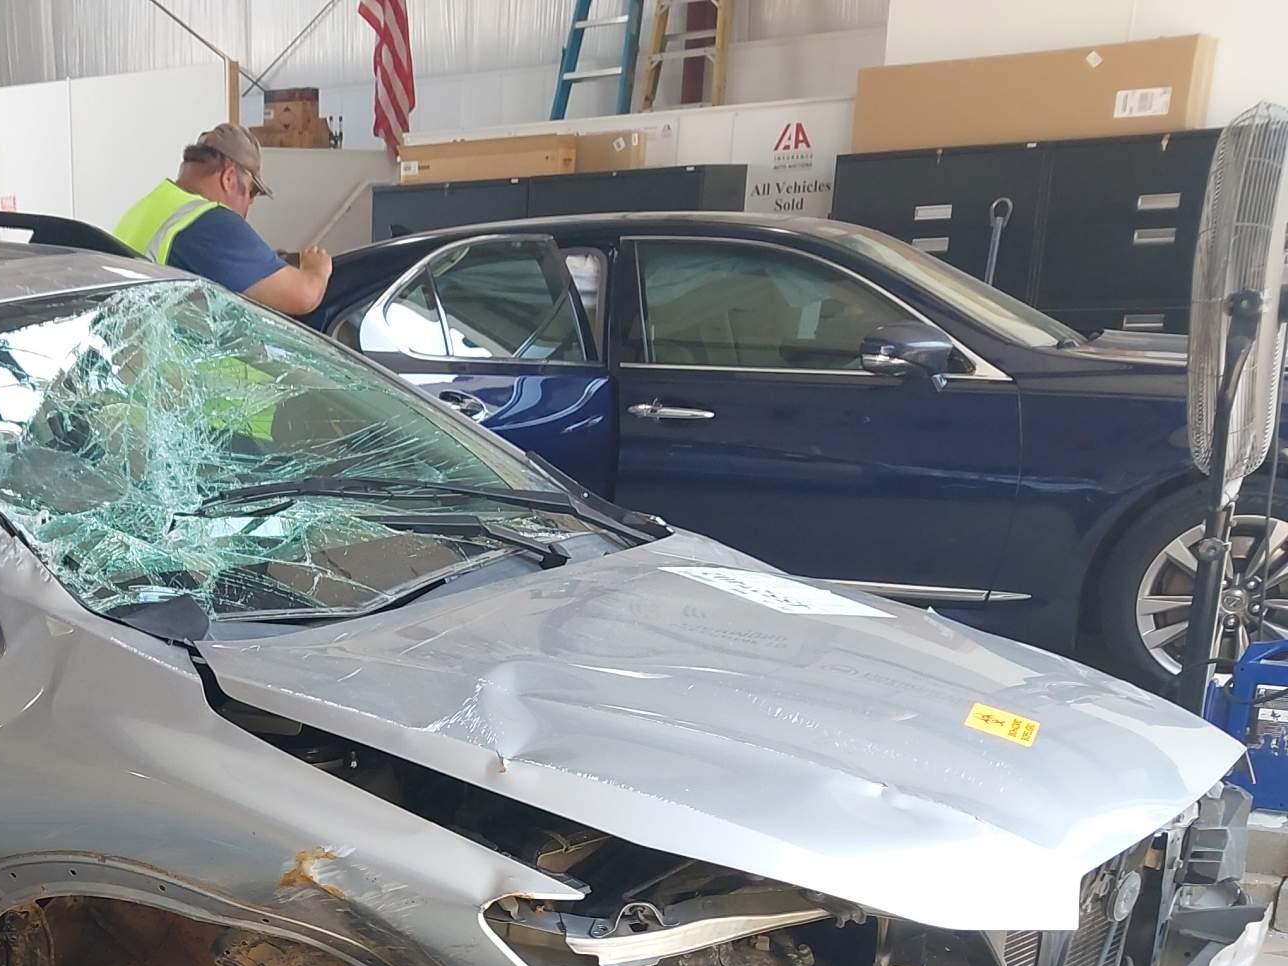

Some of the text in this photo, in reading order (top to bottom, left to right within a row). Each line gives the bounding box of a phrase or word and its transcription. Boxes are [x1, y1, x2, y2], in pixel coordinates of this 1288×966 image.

[752, 180, 831, 196] All Vehicles
[775, 198, 804, 211] Sold
